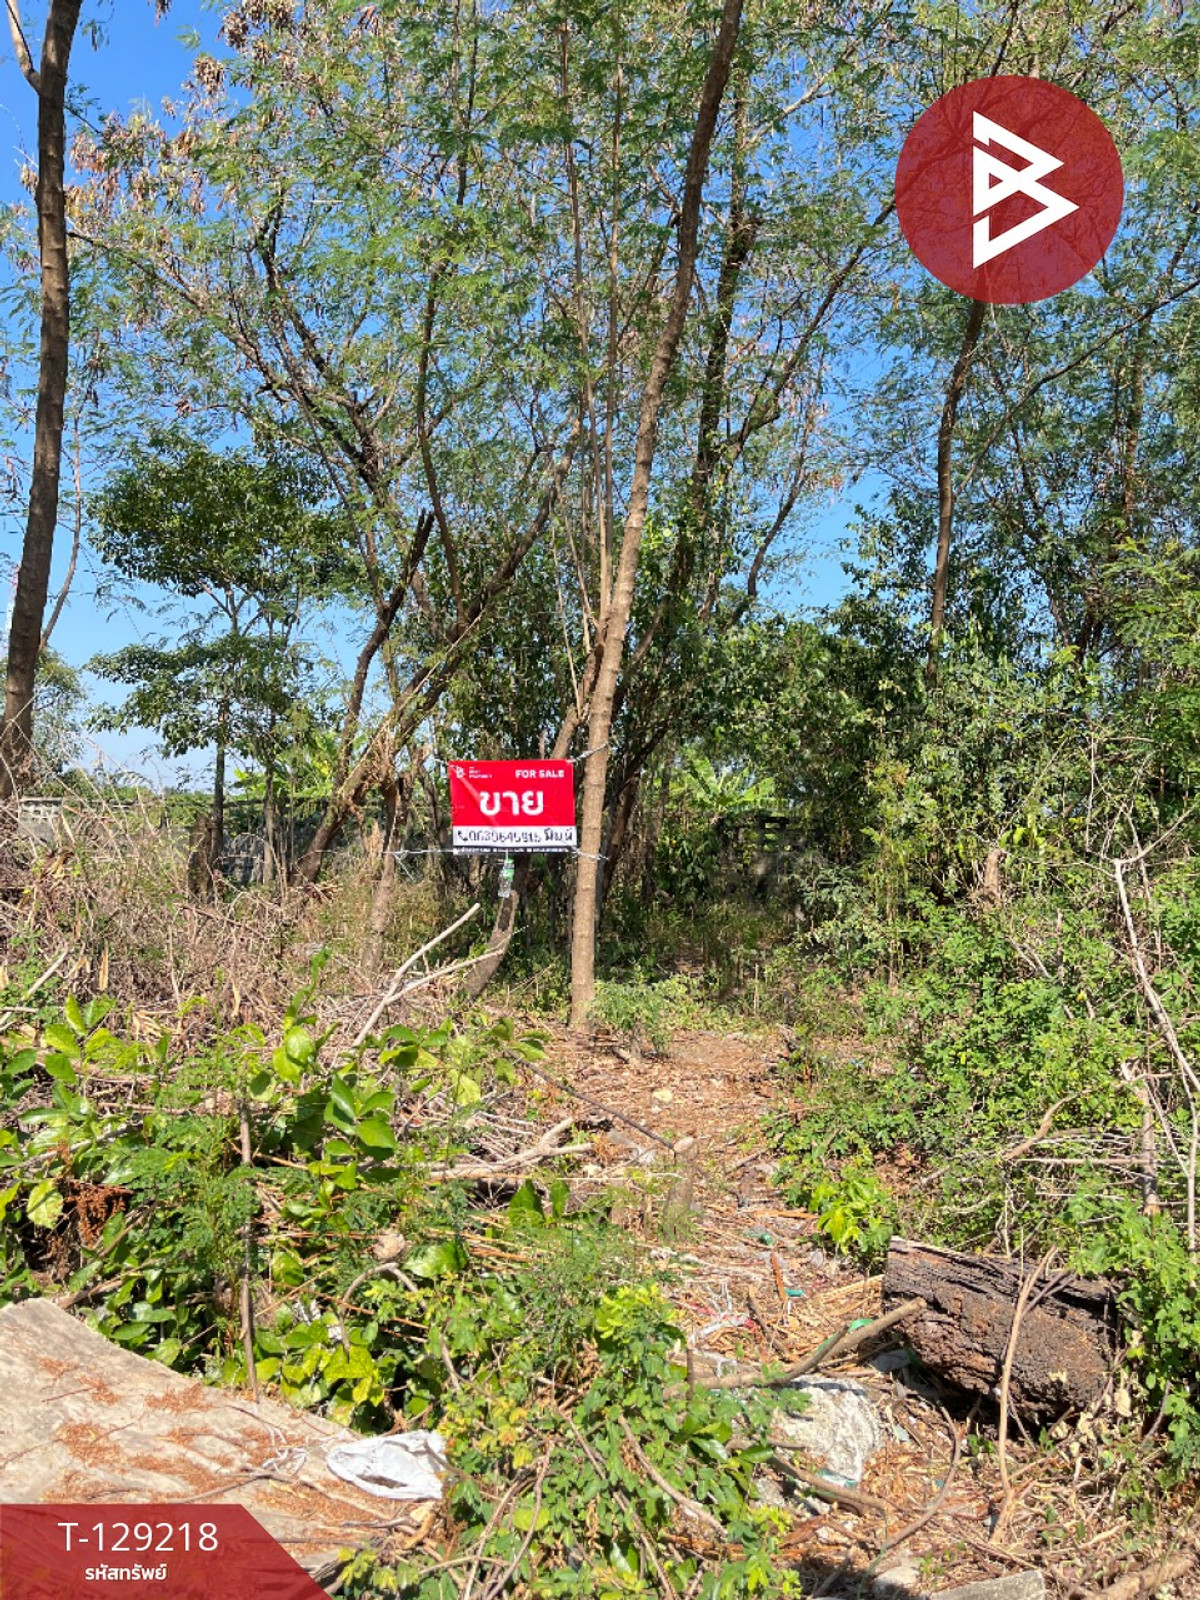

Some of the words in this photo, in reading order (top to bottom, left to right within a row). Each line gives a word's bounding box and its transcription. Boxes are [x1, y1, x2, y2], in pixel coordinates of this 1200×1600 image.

[515, 769, 537, 779] FOR
[538, 769, 565, 779] SALE
[479, 790, 544, 816] ขาย
